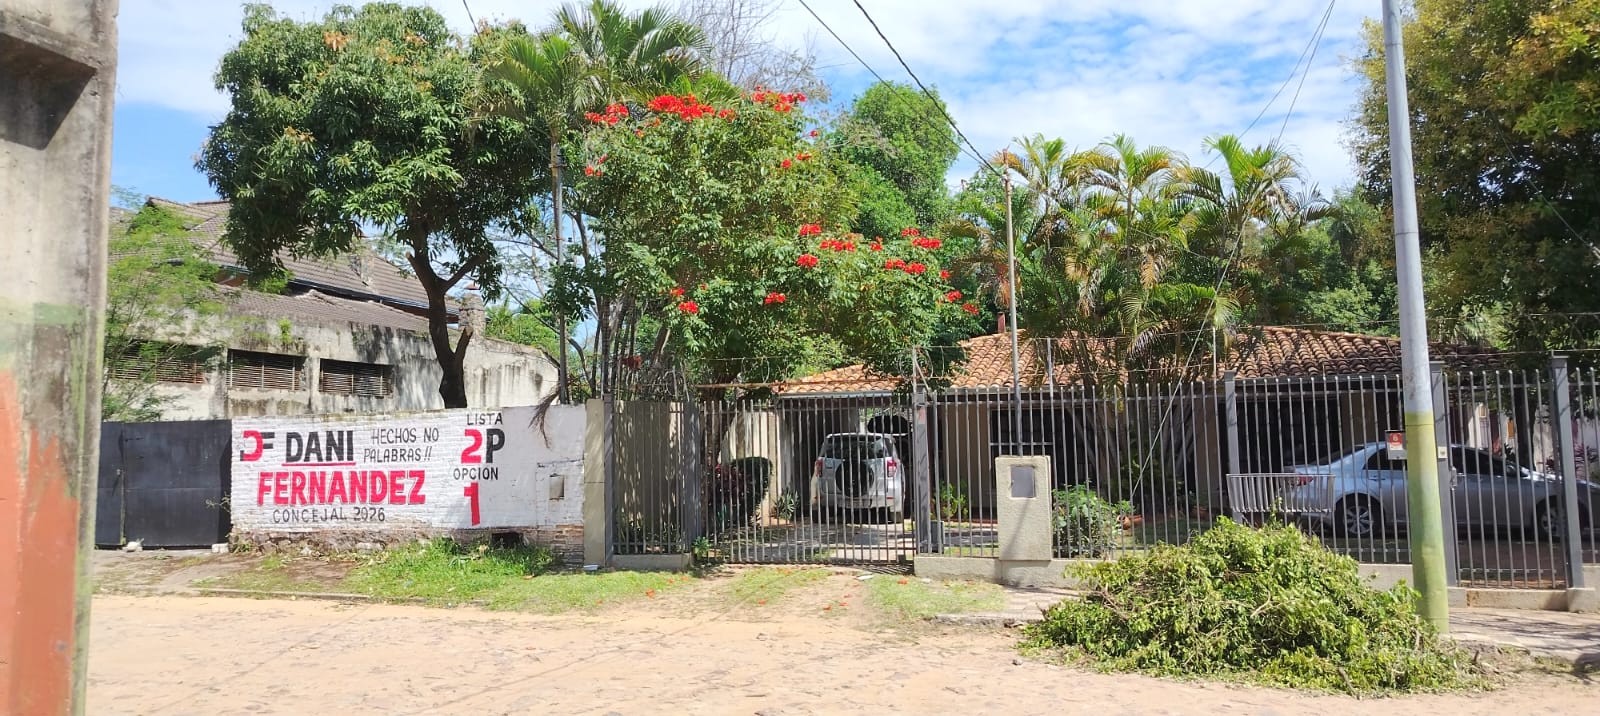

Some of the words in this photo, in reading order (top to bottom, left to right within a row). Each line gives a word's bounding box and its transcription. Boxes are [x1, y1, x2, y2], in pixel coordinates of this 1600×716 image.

[467, 412, 503, 425] LISTA
[286, 430, 354, 463] DANI
[371, 428, 417, 444] HECHOS
[424, 428, 440, 442] NO
[461, 428, 506, 464] 2P
[453, 467, 499, 480] OPCION
[257, 470, 426, 506] FERNANDEZ
[272, 507, 347, 524] CONCEJAL
[464, 481, 481, 527] 1
